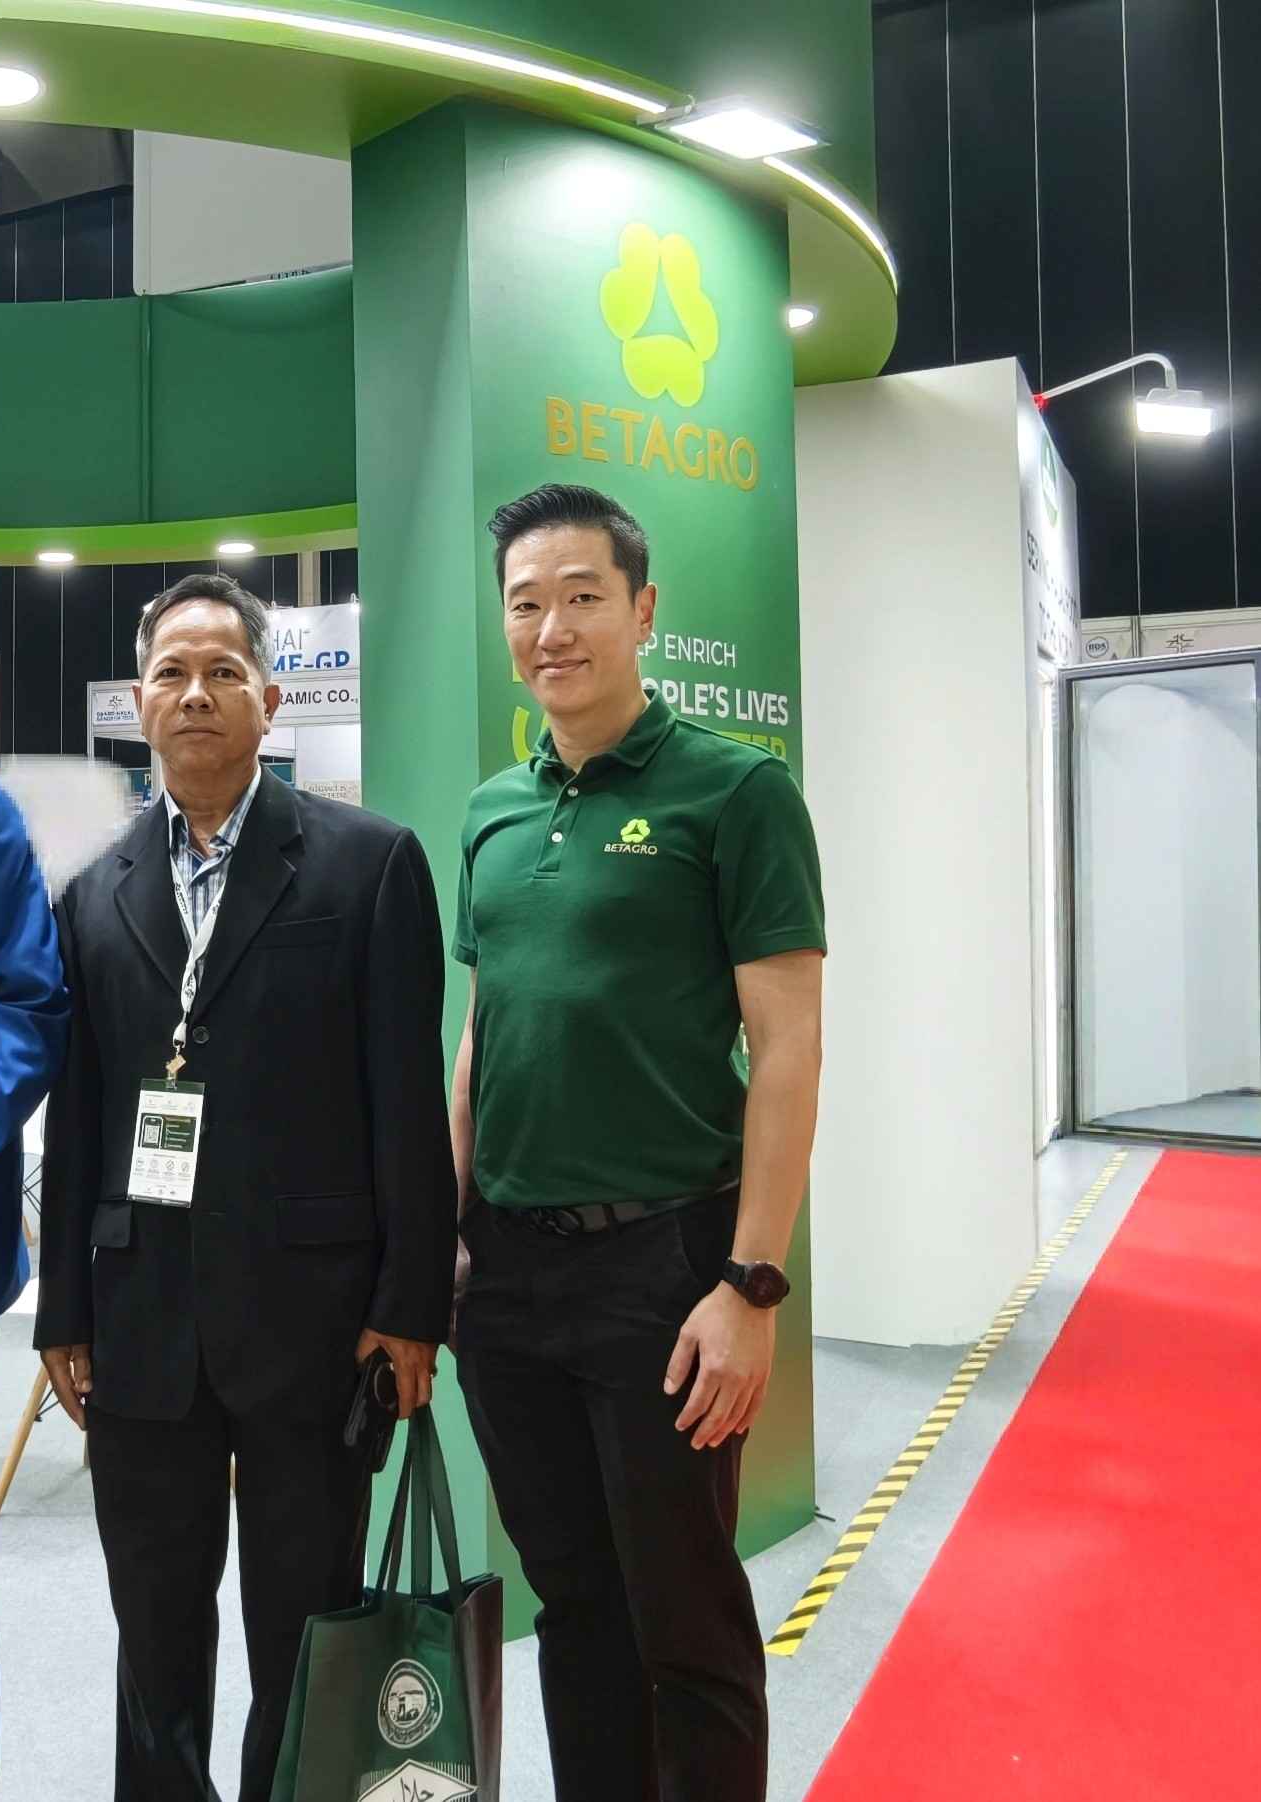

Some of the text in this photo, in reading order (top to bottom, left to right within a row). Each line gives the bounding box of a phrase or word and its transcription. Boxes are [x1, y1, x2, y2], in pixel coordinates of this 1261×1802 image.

[546, 395, 759, 492] BETAGRO
[273, 628, 303, 651] HAI
[665, 634, 736, 668] ENRICH
[273, 650, 351, 671] ME-GP
[280, 690, 322, 705] AMIC
[640, 677, 788, 726] PLE'S LIVES
[604, 843, 658, 855] BETAGRO
